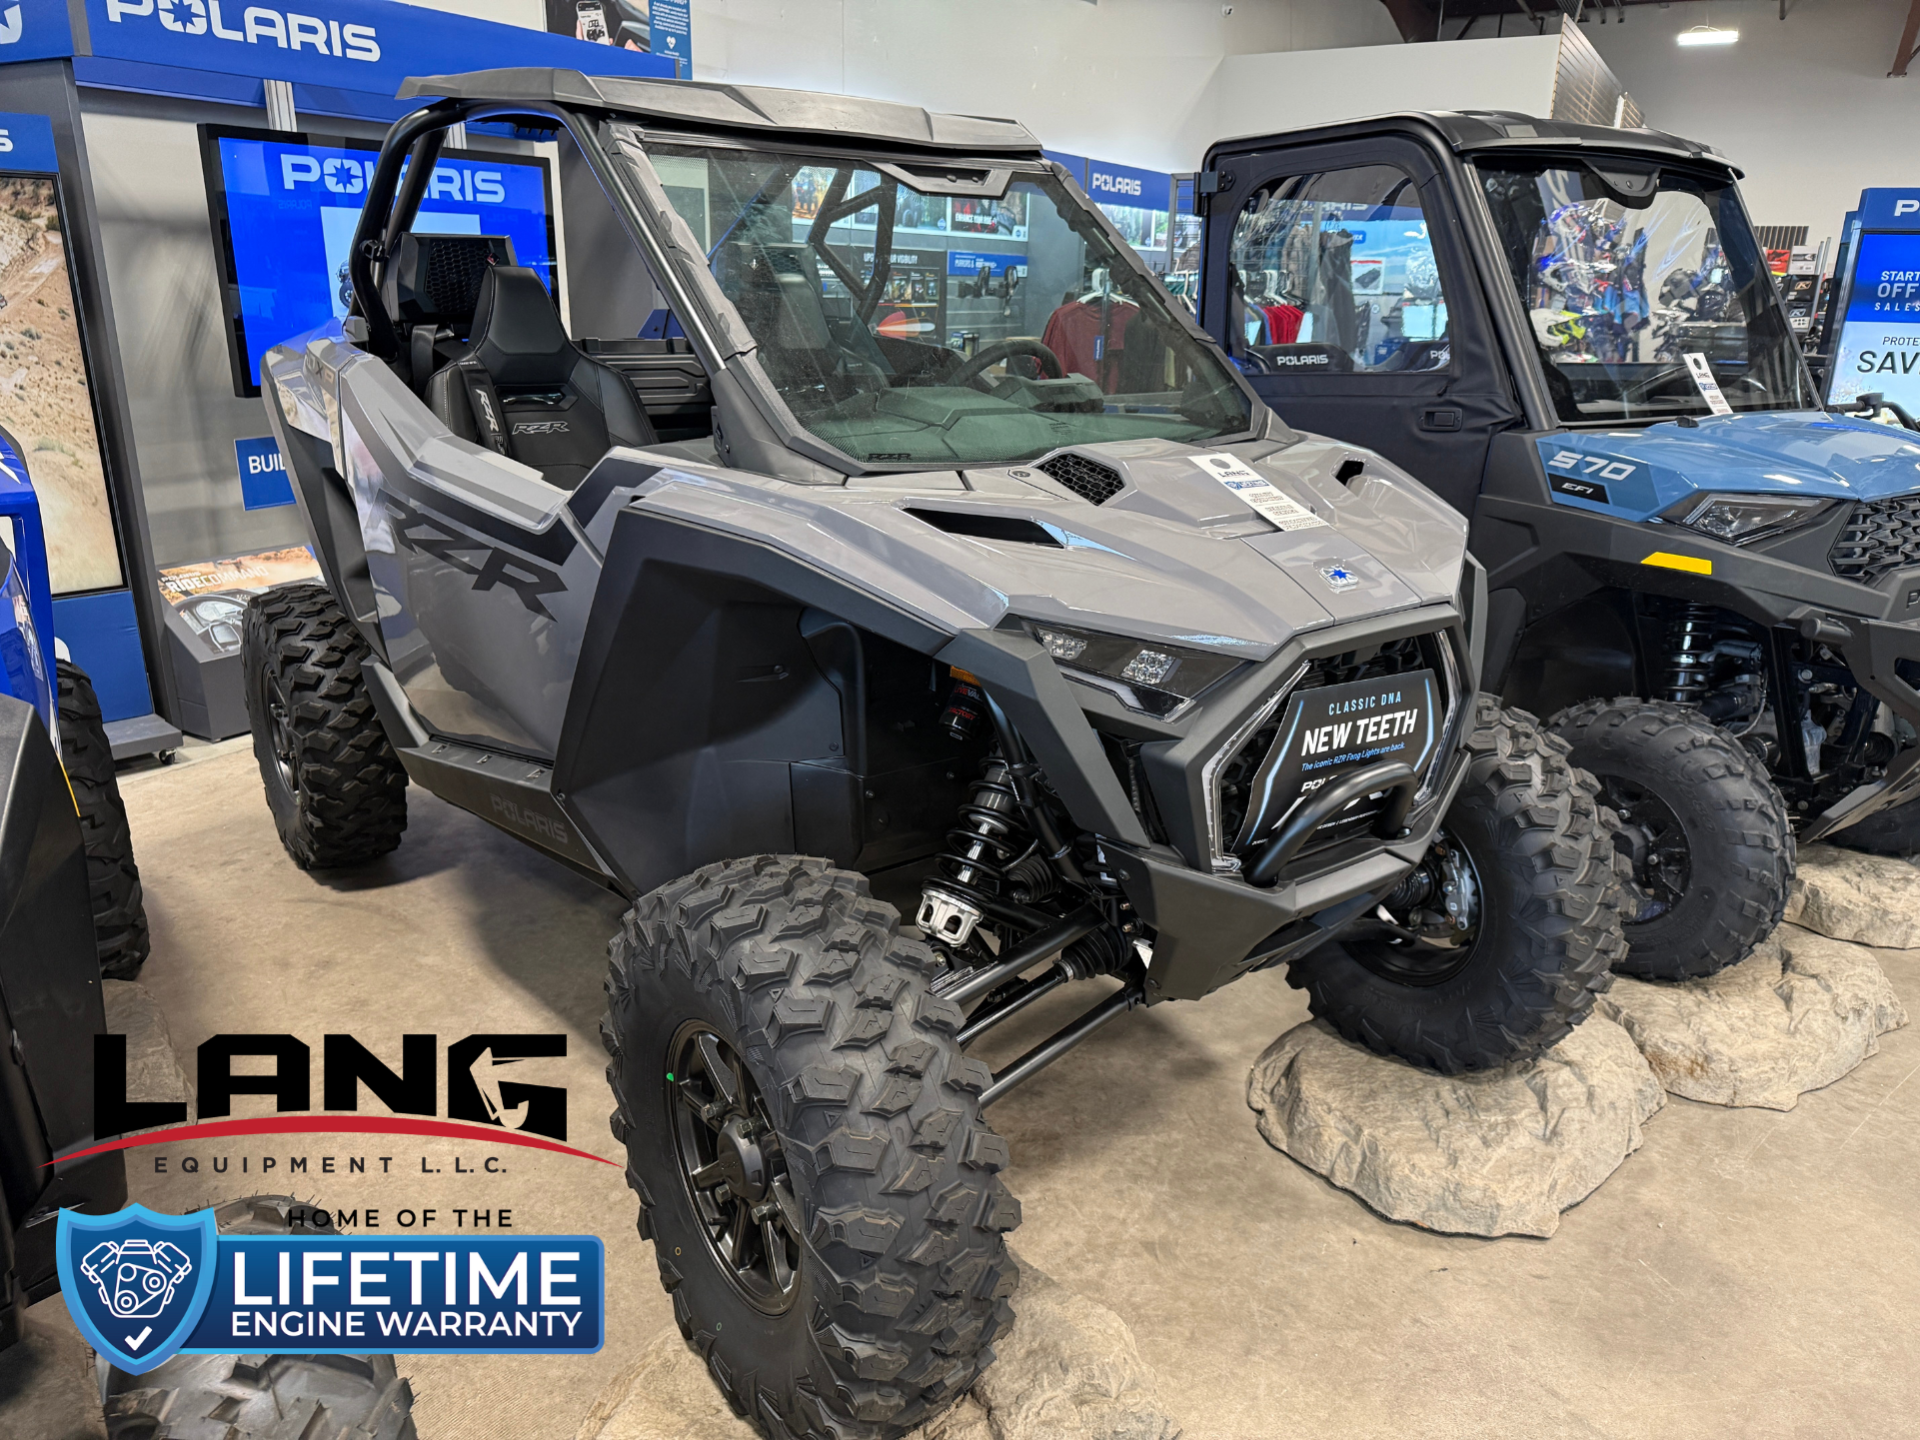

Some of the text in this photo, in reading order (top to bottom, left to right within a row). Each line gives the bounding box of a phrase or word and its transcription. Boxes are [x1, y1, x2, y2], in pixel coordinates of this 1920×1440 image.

[106, 0, 381, 62] POLARIS
[280, 153, 506, 203] PORIS
[1092, 173, 1142, 196] POLARIS
[1894, 199, 1920, 217] P
[1881, 271, 1920, 281] START
[1877, 282, 1919, 299] OFF
[1882, 336, 1920, 346] PROTE
[1277, 354, 1329, 366] POLARIS
[1857, 350, 1920, 375] SAV
[475, 389, 499, 433] RZR
[512, 421, 570, 435] RZR
[248, 454, 286, 475] BUIL
[866, 453, 911, 461] RZR
[1548, 450, 1636, 481] 570
[1561, 482, 1594, 494] EFI
[1328, 691, 1402, 716] CLASSIC DNA
[1301, 708, 1418, 757] NEW TEETH
[1301, 762, 1313, 771] The
[1314, 758, 1333, 769] iconic
[1333, 756, 1347, 765] RZR
[1346, 752, 1361, 762] Fang
[1361, 748, 1380, 759] Lights
[1380, 745, 1390, 754] are
[490, 794, 568, 844] POLARIS
